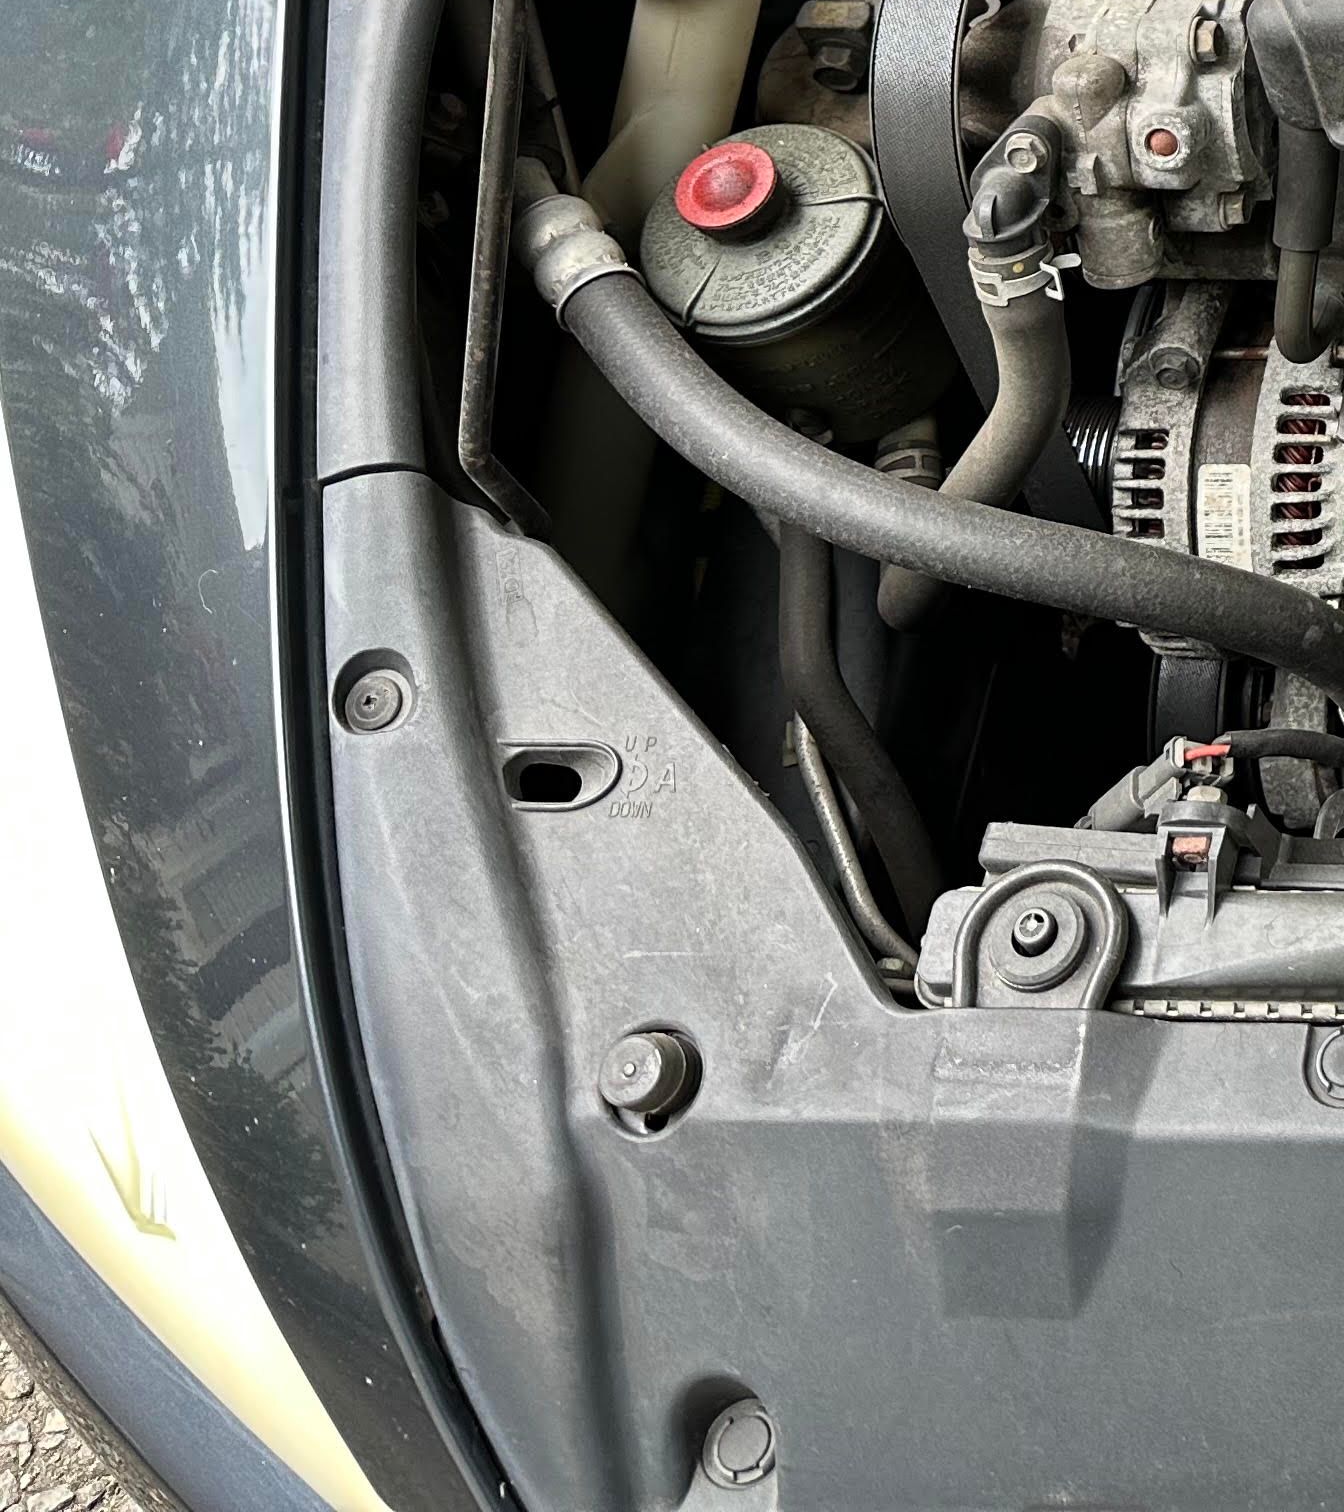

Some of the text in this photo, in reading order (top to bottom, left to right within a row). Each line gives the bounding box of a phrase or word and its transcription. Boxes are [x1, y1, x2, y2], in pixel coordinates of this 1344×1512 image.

[625, 735, 658, 753] UP
[653, 761, 677, 794] A
[608, 800, 654, 819] DOWN
